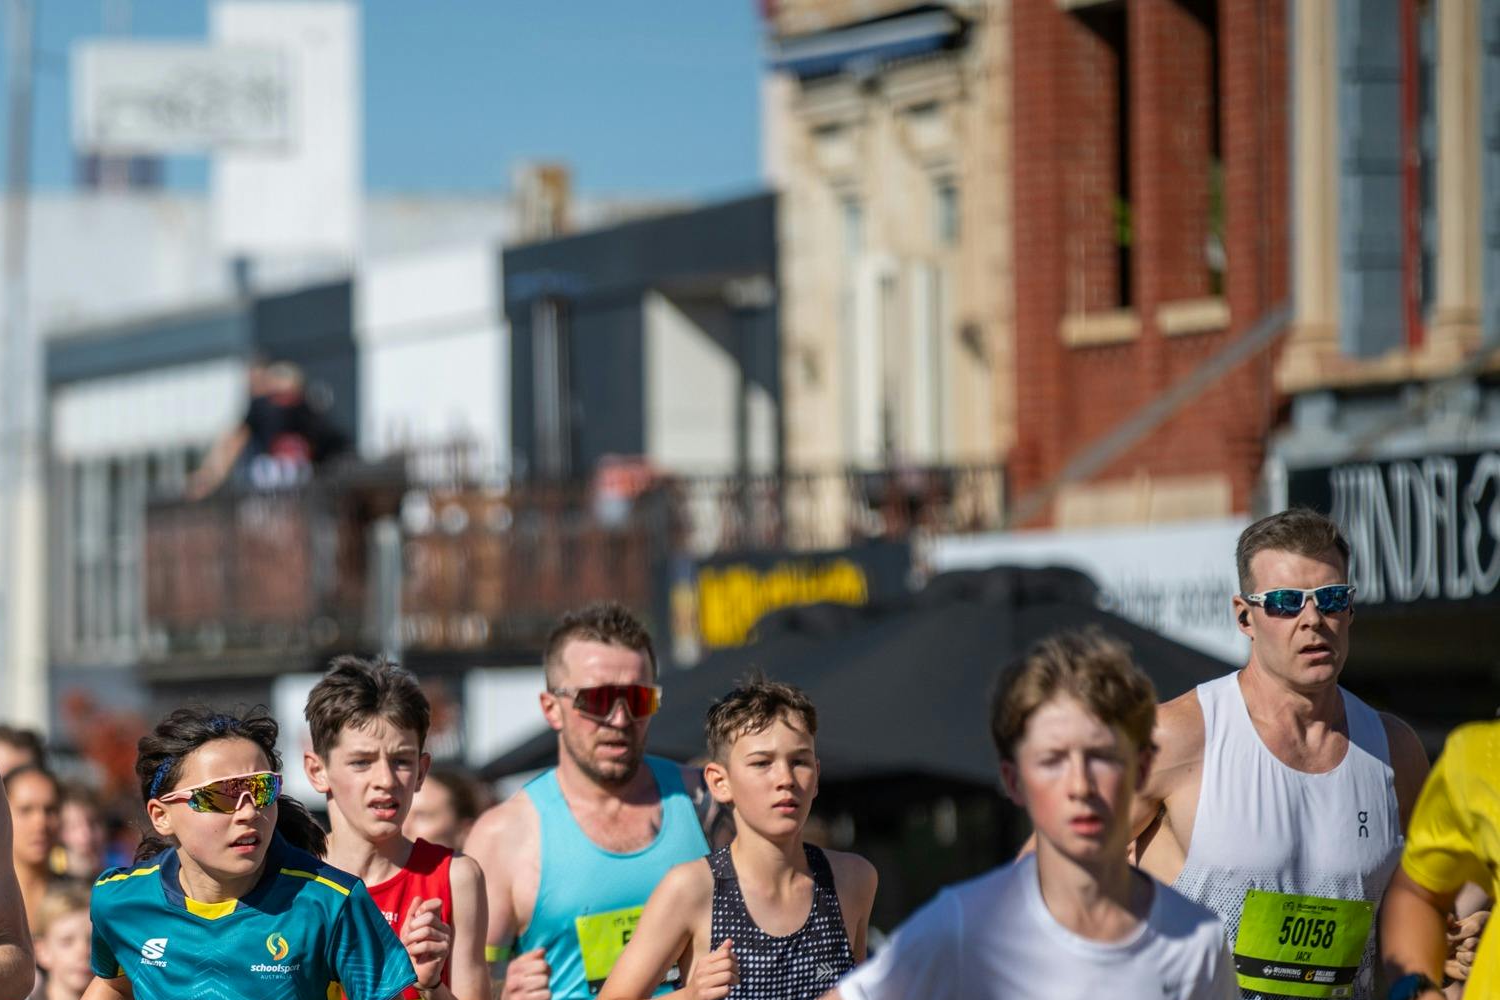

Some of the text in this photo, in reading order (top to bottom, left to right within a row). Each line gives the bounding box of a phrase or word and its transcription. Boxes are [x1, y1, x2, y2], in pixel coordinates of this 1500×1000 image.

[1279, 916, 1336, 949] 50158
[1295, 951, 1312, 962] JACK
[251, 963, 300, 974] schoolsport
